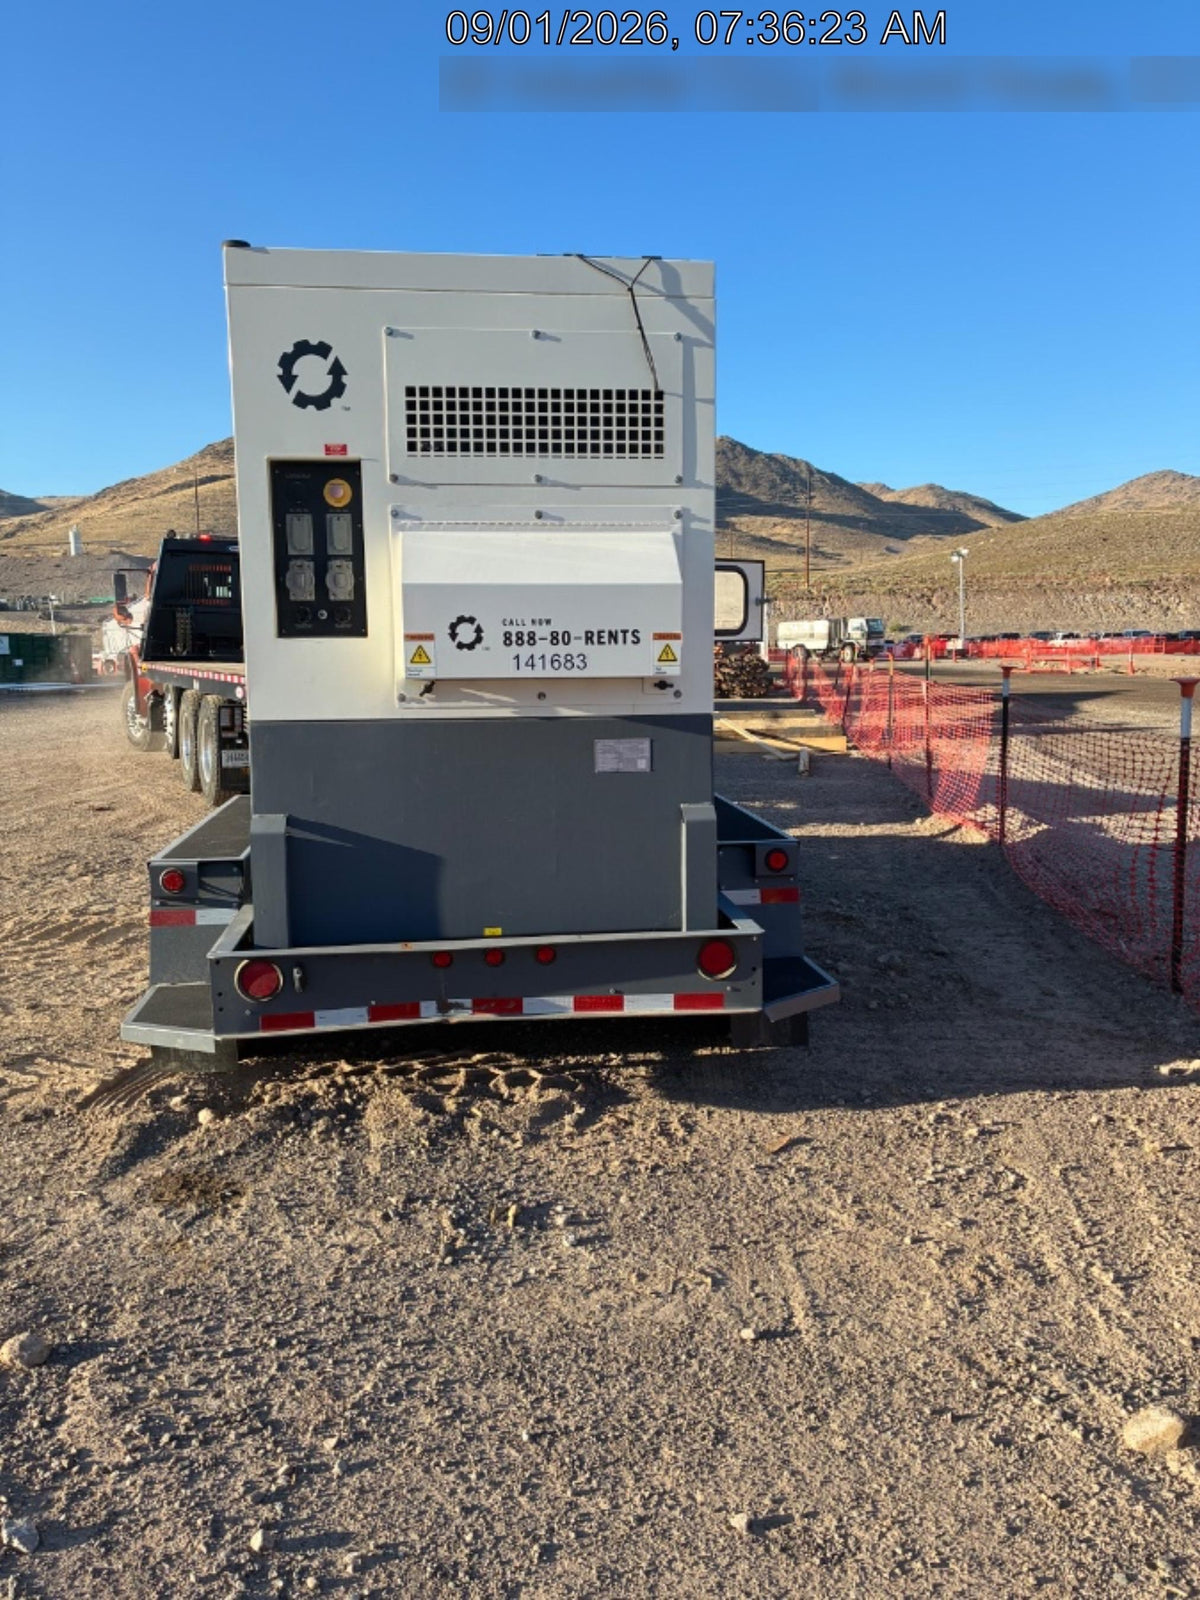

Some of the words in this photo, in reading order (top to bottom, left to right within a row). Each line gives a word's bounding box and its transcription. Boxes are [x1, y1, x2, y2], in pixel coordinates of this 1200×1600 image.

[502, 618, 526, 627] CALL
[531, 618, 552, 627] NOW
[502, 628, 641, 647] 888-80-RENTS
[512, 652, 588, 671] 141683
